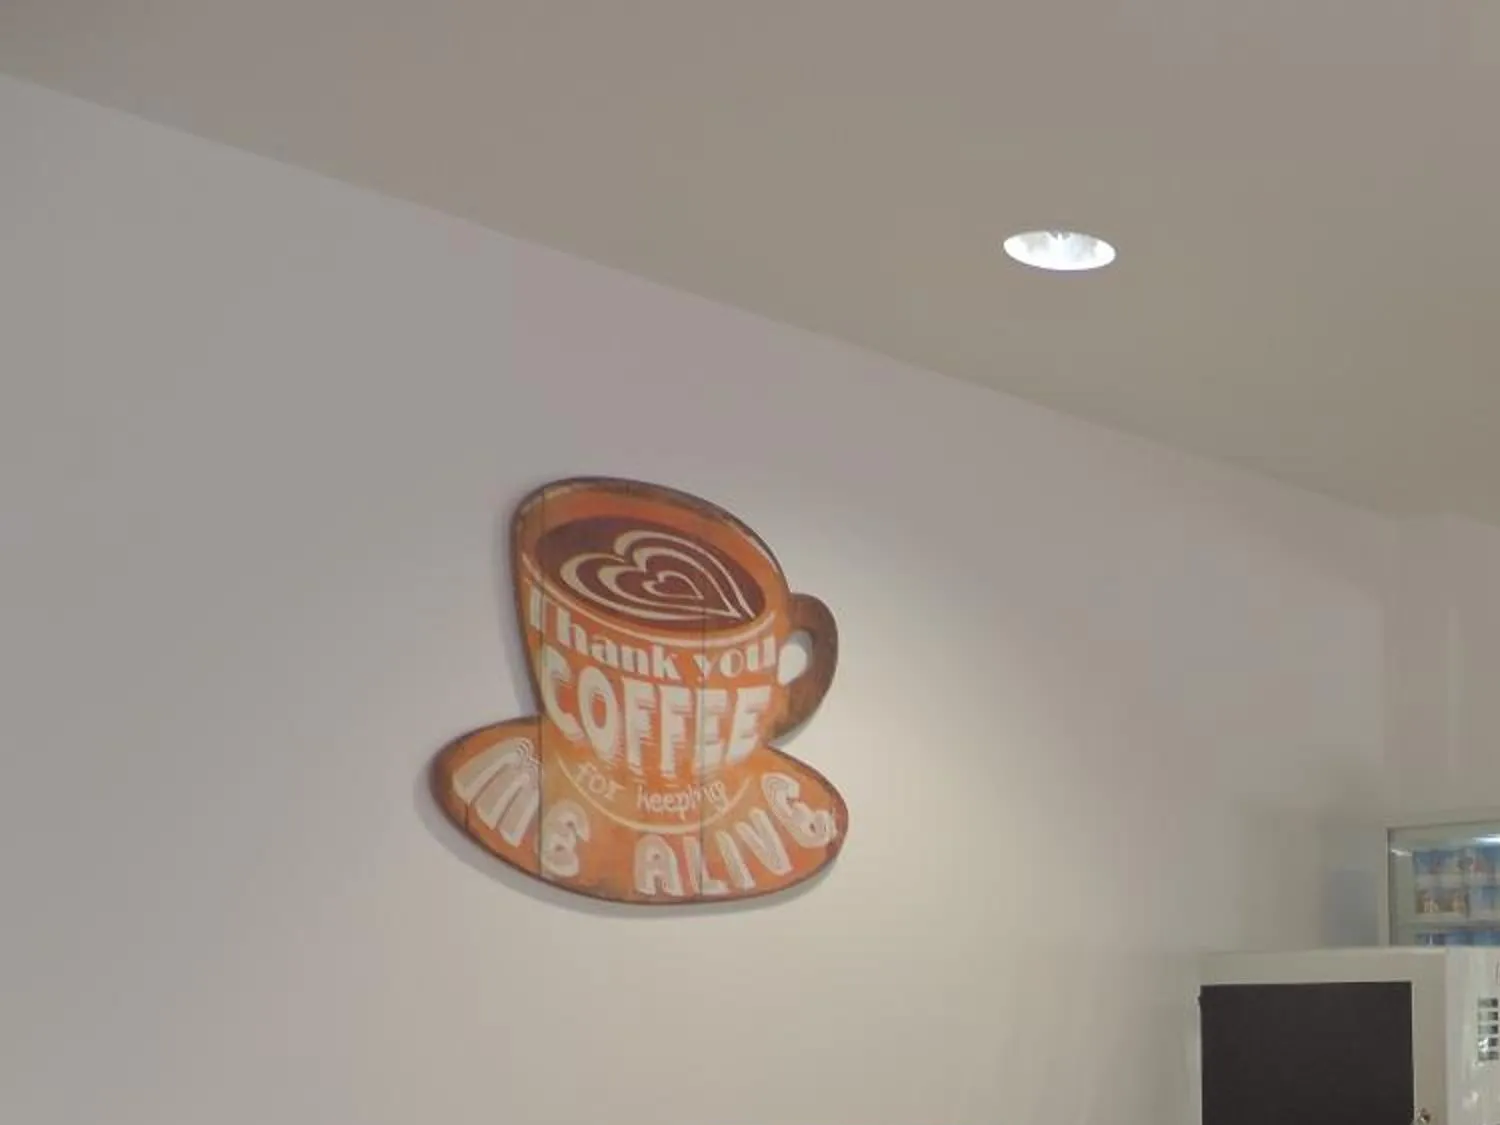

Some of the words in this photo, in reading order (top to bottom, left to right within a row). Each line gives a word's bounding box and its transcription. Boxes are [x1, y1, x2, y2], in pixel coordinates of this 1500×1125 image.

[695, 632, 777, 682] you
[537, 645, 772, 778] COFFEE
[636, 777, 730, 822] keeping
